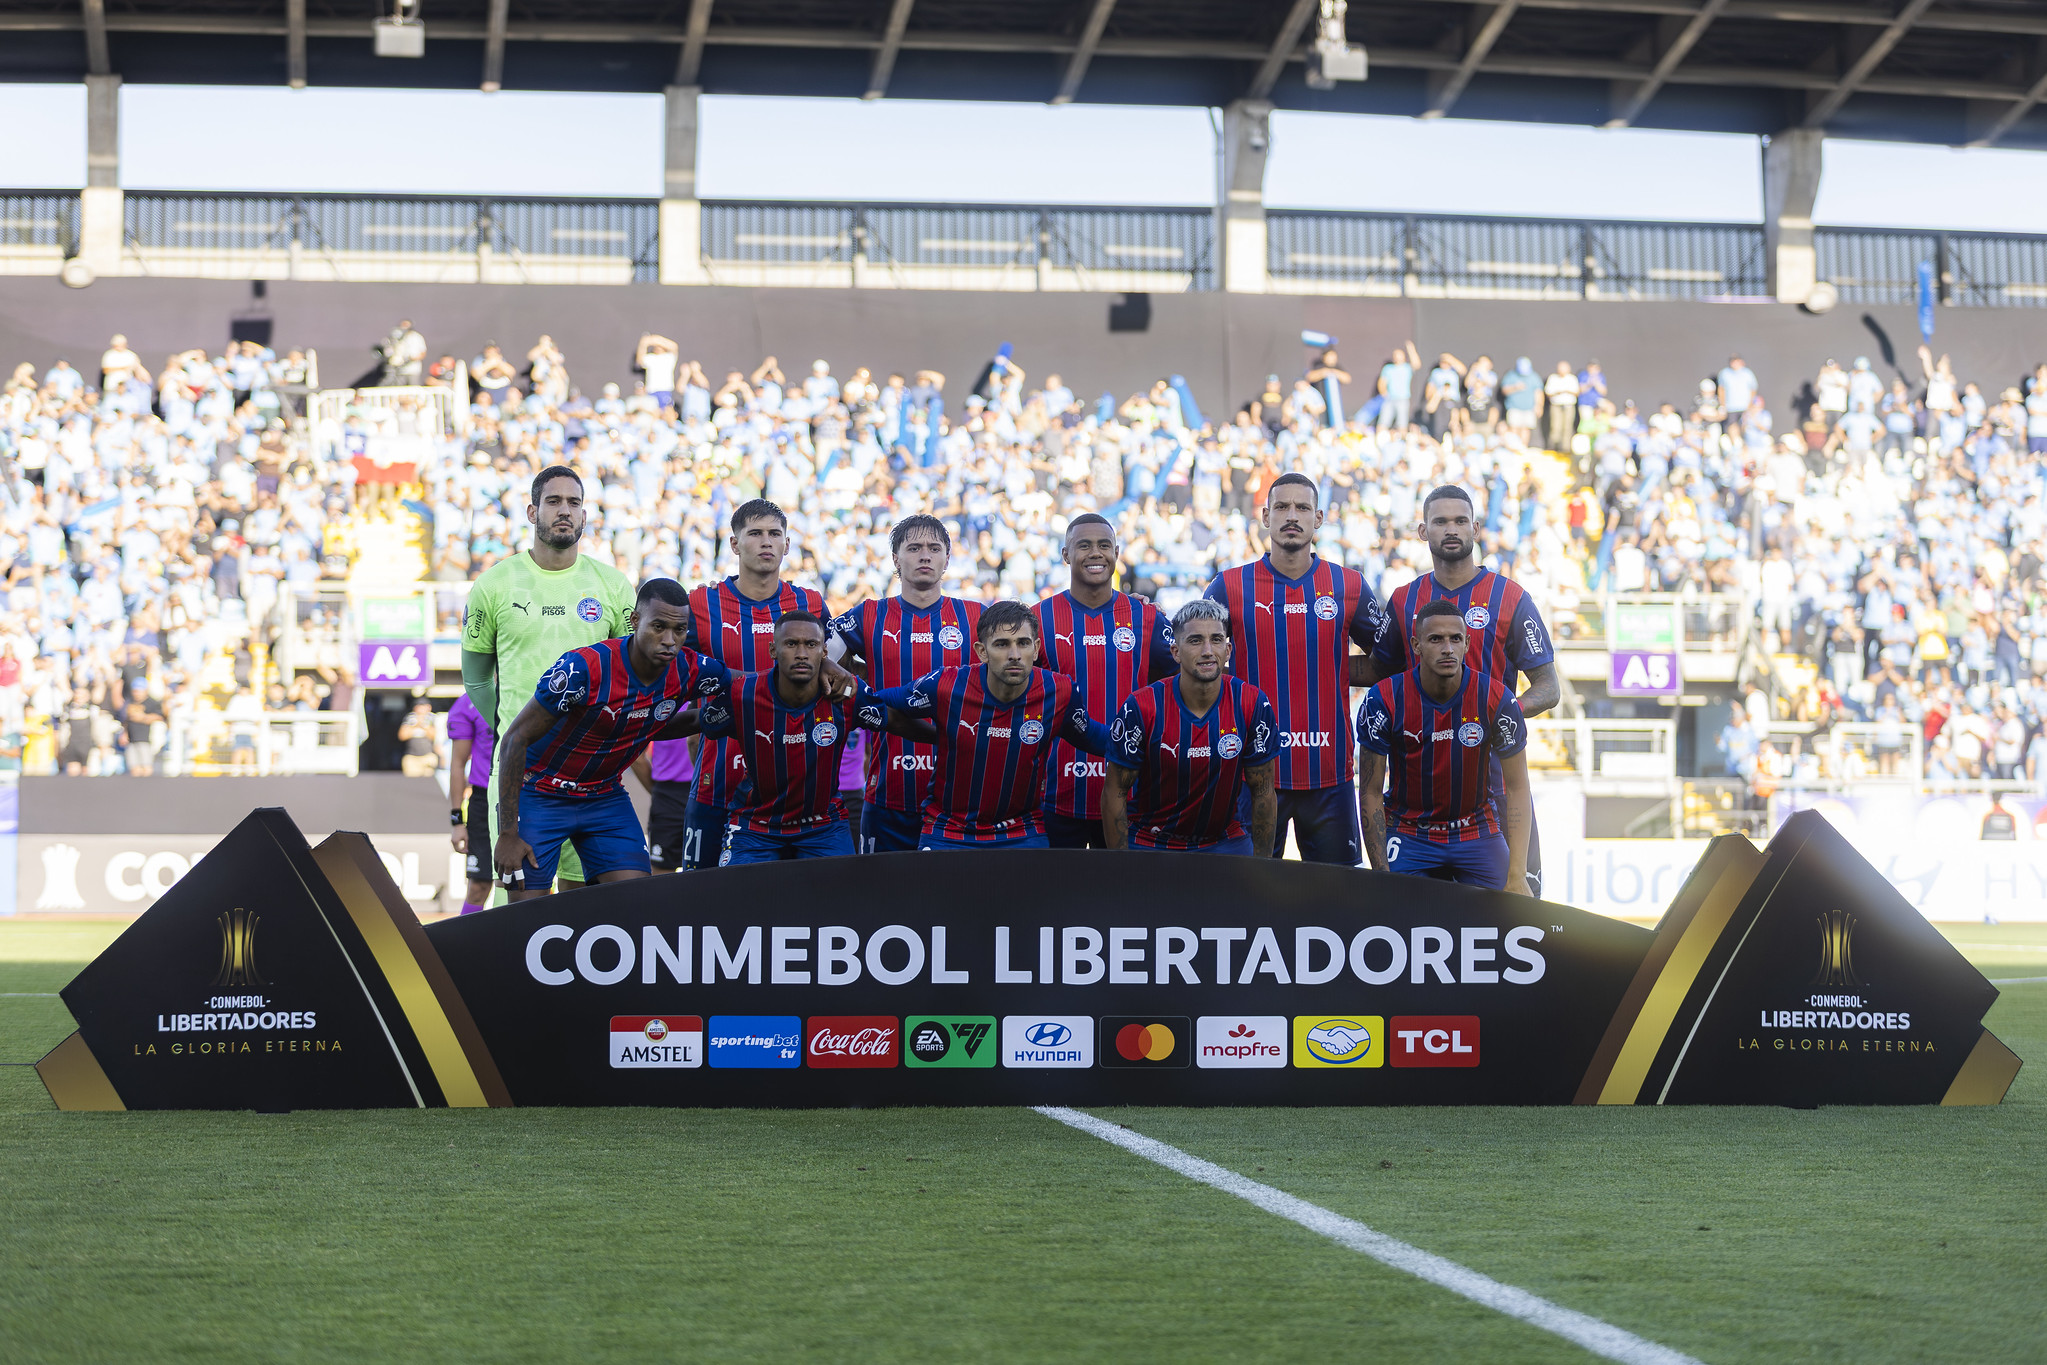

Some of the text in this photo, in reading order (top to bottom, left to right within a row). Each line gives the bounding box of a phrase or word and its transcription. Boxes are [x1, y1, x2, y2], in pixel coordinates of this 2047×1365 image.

[910, 636, 934, 644] PISOS
[1083, 638, 1106, 646] PISOS
[1524, 620, 1543, 654] Canaã
[1620, 654, 1670, 689] A5
[627, 712, 649, 720] PISOS
[986, 730, 1012, 738] PISOS
[1279, 732, 1330, 748] OXLUX
[1432, 732, 1454, 742] PISOS
[893, 754, 936, 770] FOXL
[1187, 750, 1212, 758] PISOS
[1064, 762, 1108, 778] FOXL
[684, 826, 702, 862] 21
[1566, 849, 1697, 904] libr
[526, 924, 969, 986] CONMEBOL
[995, 924, 1546, 986] LIBERTADORES
[158, 1011, 316, 1032] LIBERTADORES
[1761, 1010, 1911, 1030] LIBERTADORES
[710, 1034, 800, 1049] sportingbet
[810, 1027, 896, 1056] Coca-Cola
[916, 1029, 944, 1044] EA
[1398, 1030, 1472, 1054] TCL
[134, 1040, 342, 1056] LA GLORIA ETERNA
[916, 1044, 944, 1052] SPORTS
[1203, 1040, 1280, 1060] mapfre
[1738, 1038, 1935, 1052] LA GLORIA ETERNA
[620, 1046, 692, 1063] AMSTEL
[1014, 1050, 1082, 1062] HYUNDAI
